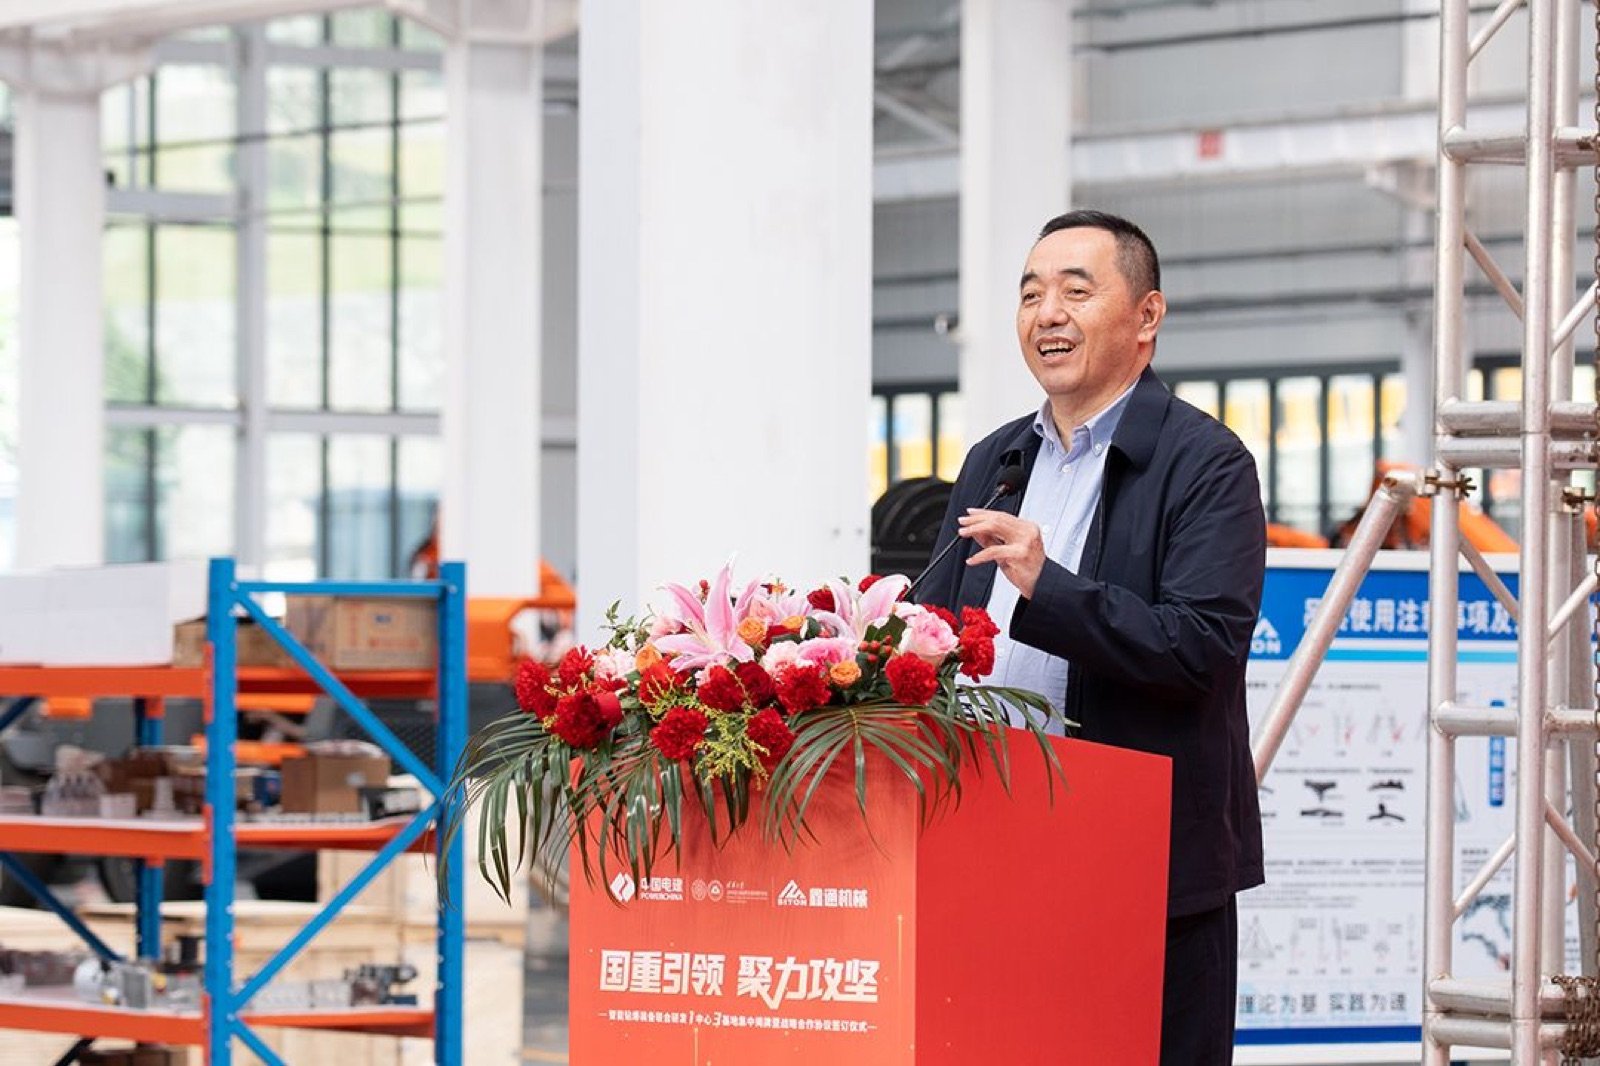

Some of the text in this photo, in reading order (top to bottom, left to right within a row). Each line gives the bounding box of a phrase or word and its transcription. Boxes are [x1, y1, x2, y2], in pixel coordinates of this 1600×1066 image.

[809, 888, 868, 909] 鑫通机械
[600, 949, 880, 1010] 国重引领 聚力攻坚
